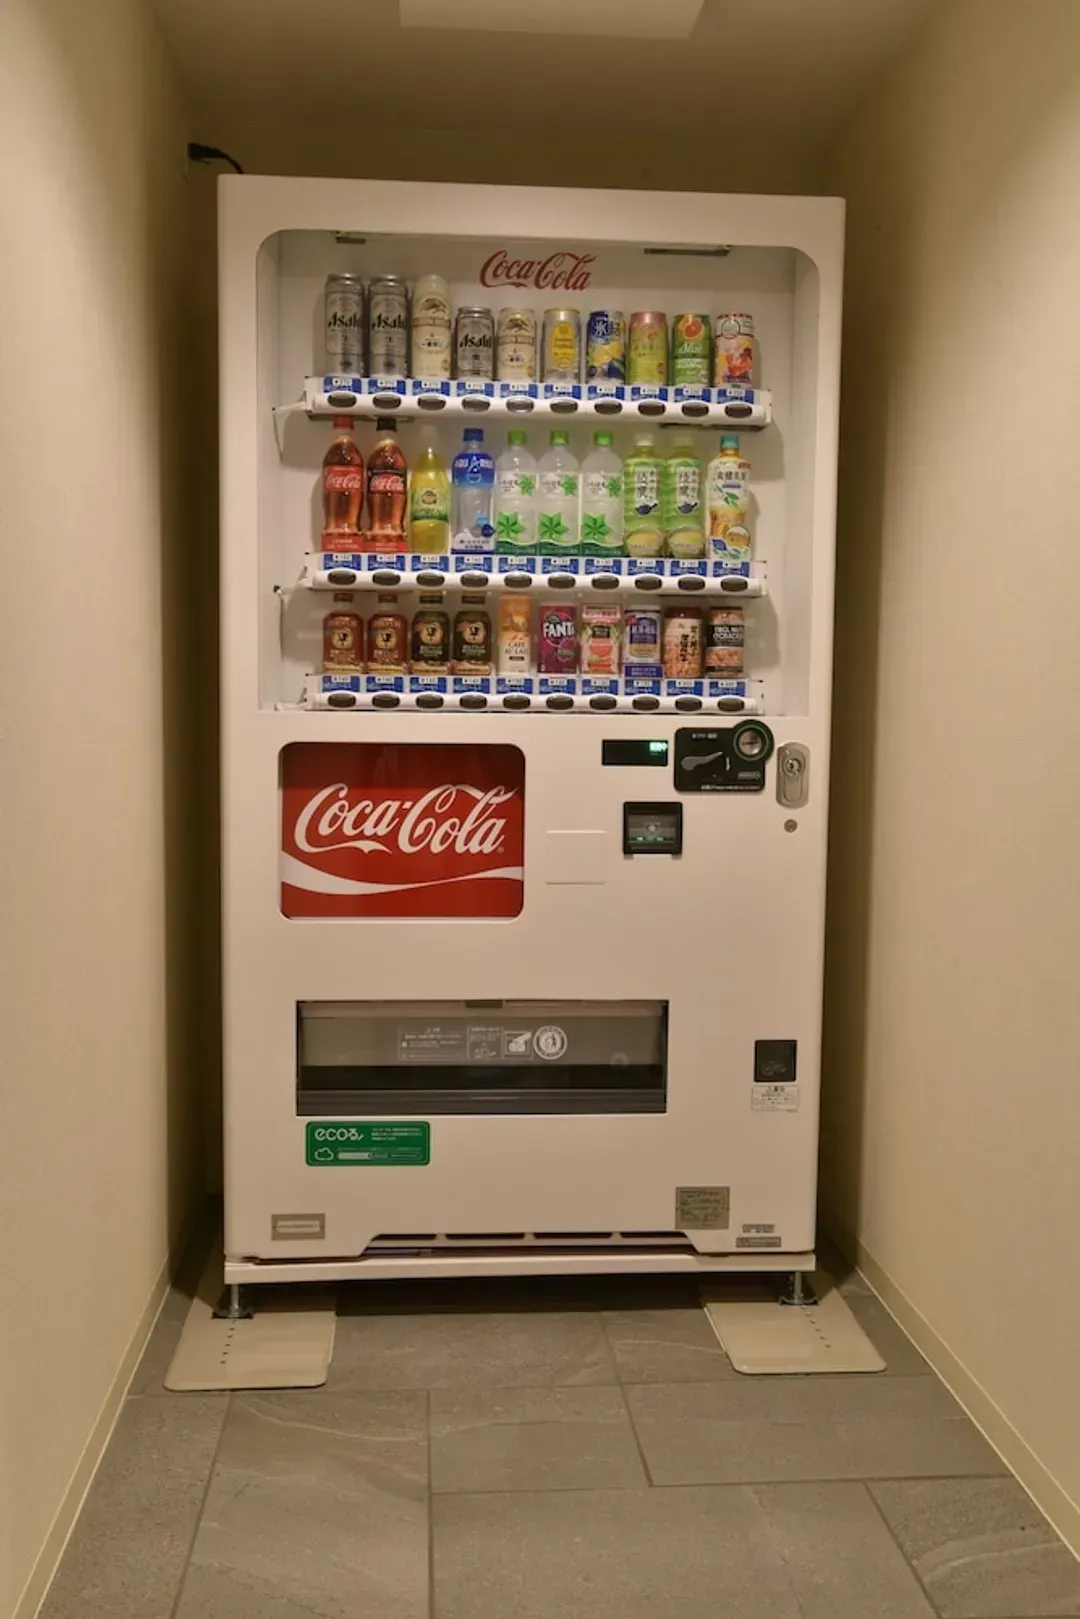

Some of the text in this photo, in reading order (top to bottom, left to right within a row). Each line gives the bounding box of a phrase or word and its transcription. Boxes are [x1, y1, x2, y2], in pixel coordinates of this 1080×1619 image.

[479, 250, 597, 291] Coca-Cola
[542, 621, 575, 638] FANT
[294, 783, 519, 855] Coca-Cola
